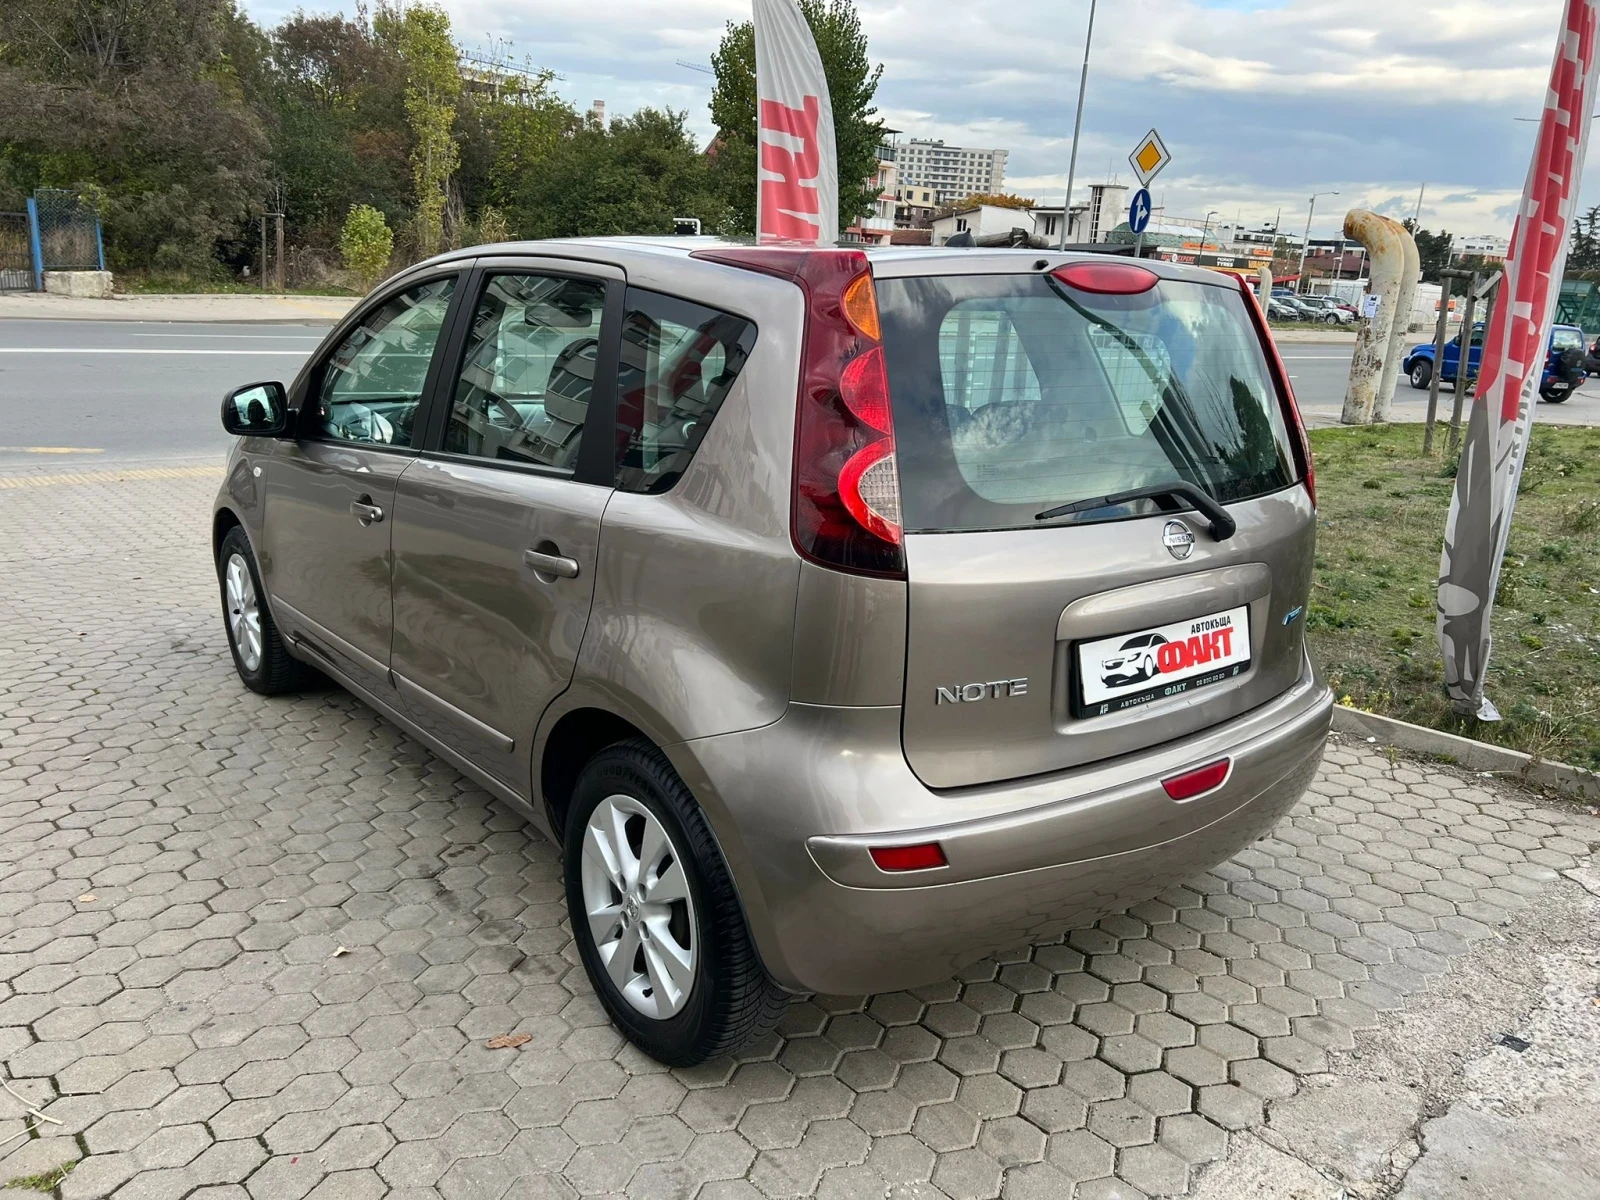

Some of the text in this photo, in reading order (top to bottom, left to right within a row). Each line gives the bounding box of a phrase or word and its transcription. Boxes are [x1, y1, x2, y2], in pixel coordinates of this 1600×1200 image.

[1169, 534, 1195, 544] NISSAN
[1190, 615, 1232, 634] АВТОКЪЩА
[1157, 627, 1234, 674] ФАКТ
[935, 677, 1028, 705] NOTE
[1164, 682, 1187, 696] ФАКТ
